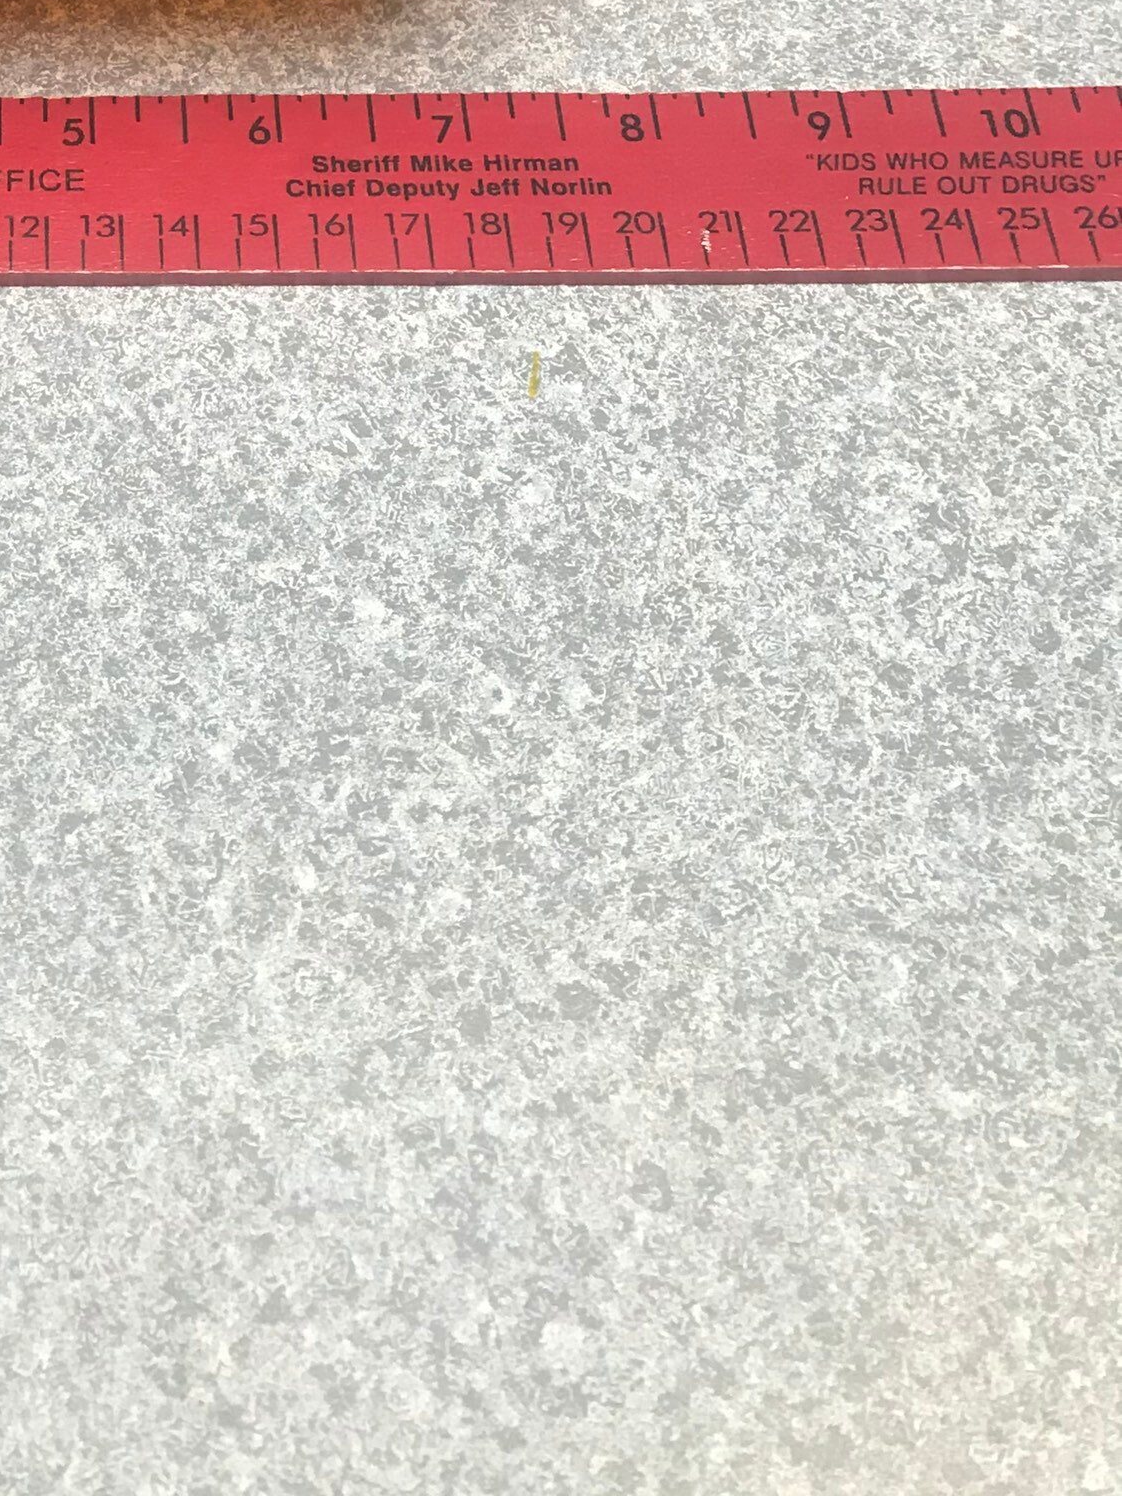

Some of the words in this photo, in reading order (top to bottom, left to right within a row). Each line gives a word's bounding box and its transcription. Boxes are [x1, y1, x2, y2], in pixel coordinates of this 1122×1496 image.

[63, 119, 84, 147] 5
[248, 116, 271, 145] 6
[431, 115, 454, 143] 7
[619, 113, 645, 142] 8
[807, 111, 830, 141] 9
[980, 108, 1030, 139] 10
[312, 155, 400, 173] Sheriff
[411, 155, 473, 172] Mike
[483, 155, 579, 172] Hirman
[806, 152, 877, 171] "KIDS
[886, 152, 949, 171] WHO
[959, 150, 1083, 170] MEASURE
[285, 179, 356, 198] Chief
[366, 179, 460, 201] Deputy
[471, 179, 520, 197] Jeff
[532, 178, 612, 196] Norlin
[859, 176, 926, 195] RULE
[938, 175, 991, 195] OUT
[1003, 174, 1106, 195] DRUGS"
[8, 216, 41, 239] 12
[81, 215, 117, 238] 13
[154, 215, 191, 237] 14
[232, 213, 269, 237] 15
[308, 213, 346, 237] 16
[383, 213, 420, 236] 17
[463, 212, 502, 236] 18
[541, 212, 579, 235] 19
[613, 211, 656, 235] 20
[698, 210, 733, 234] 21
[769, 210, 811, 233] 22
[845, 209, 889, 232] 23
[920, 208, 964, 231] 24
[997, 207, 1040, 230] 25
[1074, 205, 1119, 229] 26
